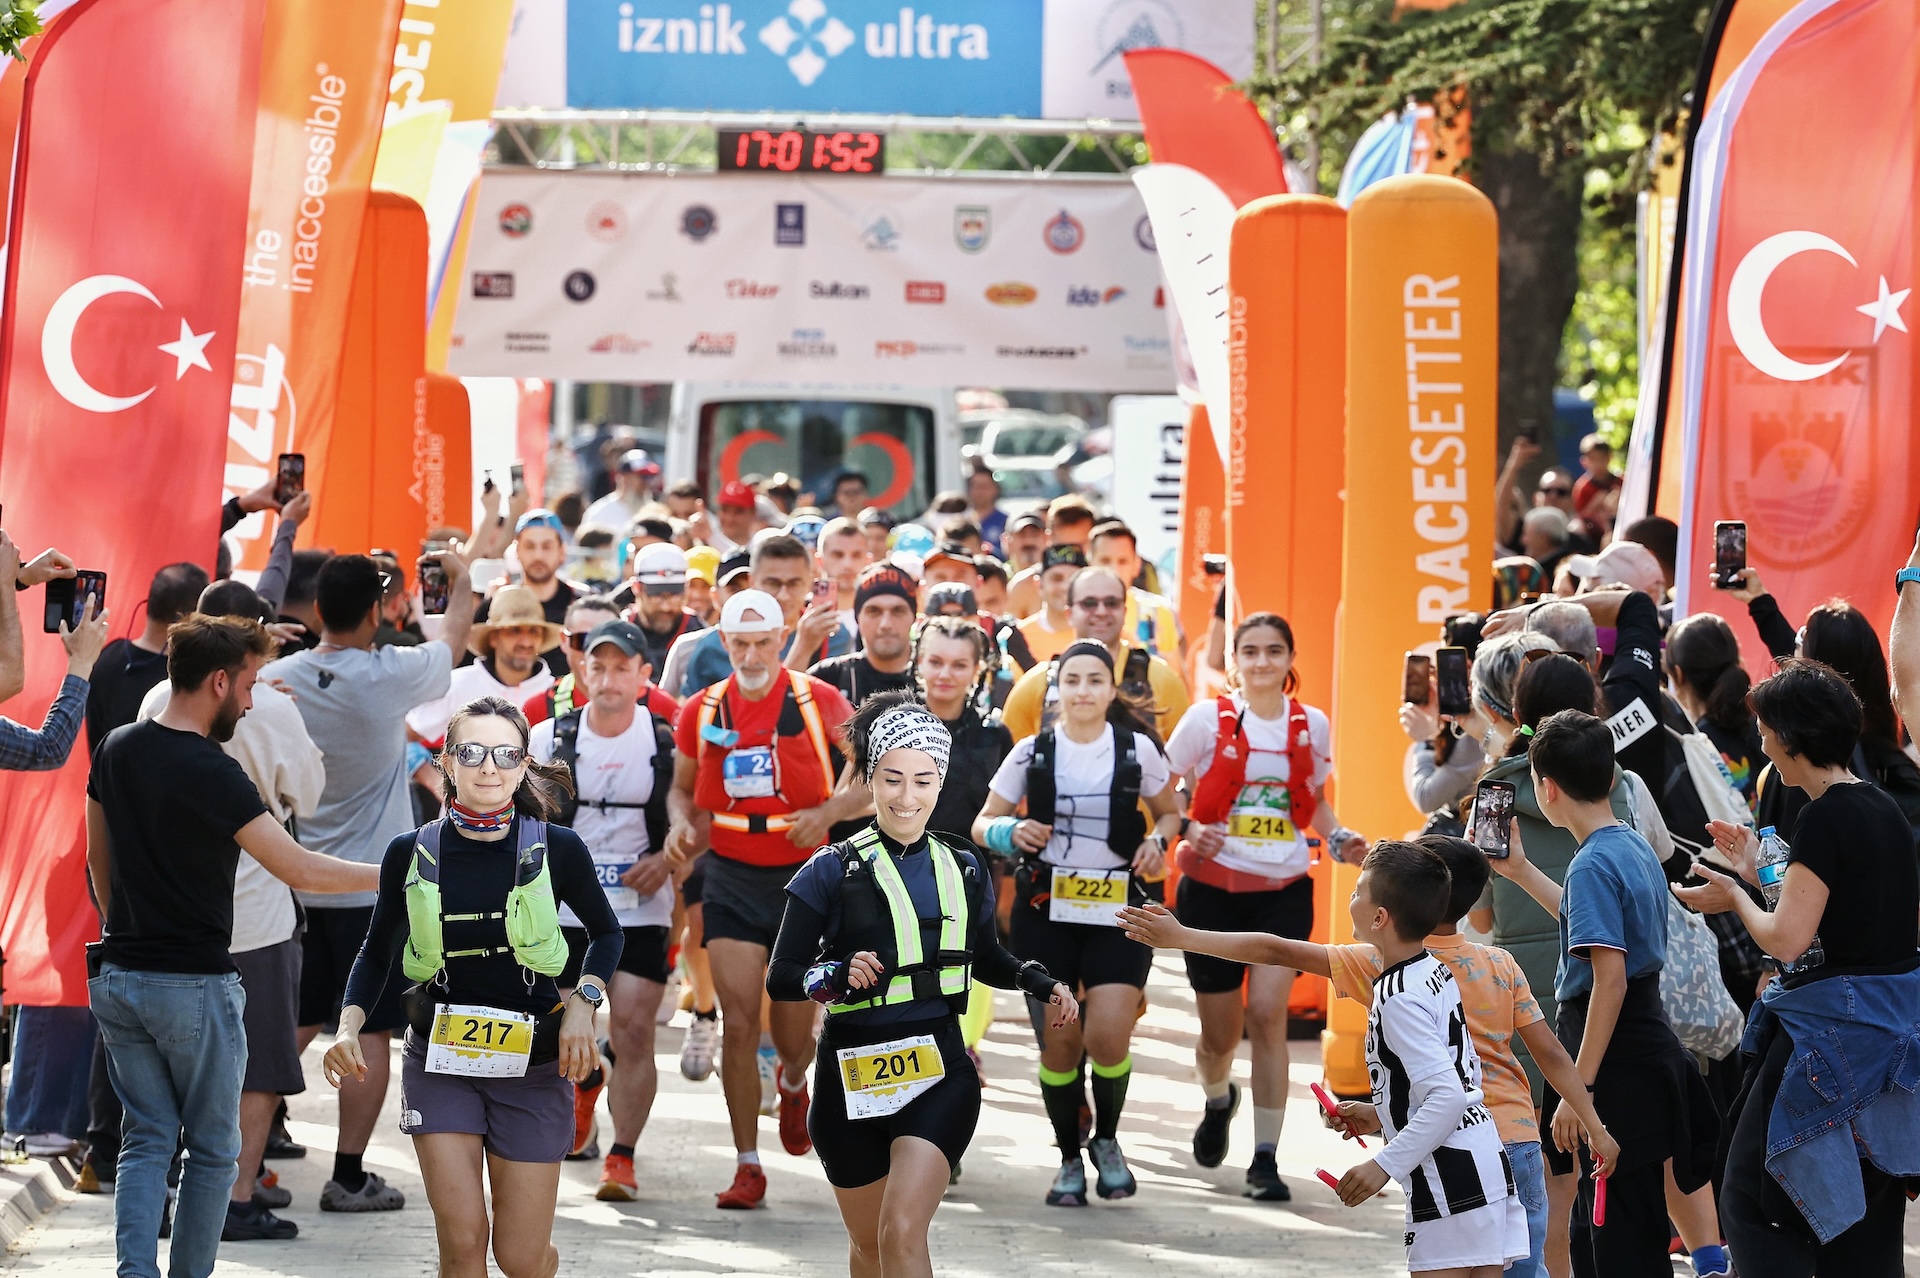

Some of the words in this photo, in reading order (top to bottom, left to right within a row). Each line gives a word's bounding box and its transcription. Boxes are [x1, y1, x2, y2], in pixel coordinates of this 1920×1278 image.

[617, 2, 747, 54] iznik
[864, 7, 990, 60] ultra
[735, 130, 880, 173] 17:01:52
[243, 229, 282, 287] the
[1229, 295, 1249, 506] inaccessible
[407, 378, 427, 503] Access
[1402, 273, 1471, 625] RACESETTER
[885, 725, 930, 751] SALOMON
[1611, 709, 1647, 741] NER
[1250, 817, 1285, 836] 214
[594, 865, 619, 884] 26
[1076, 879, 1112, 899] 222
[439, 1022, 448, 1036] 75K
[461, 1019, 514, 1045] 217
[849, 1068, 858, 1082] 75K
[872, 1050, 920, 1081] 201
